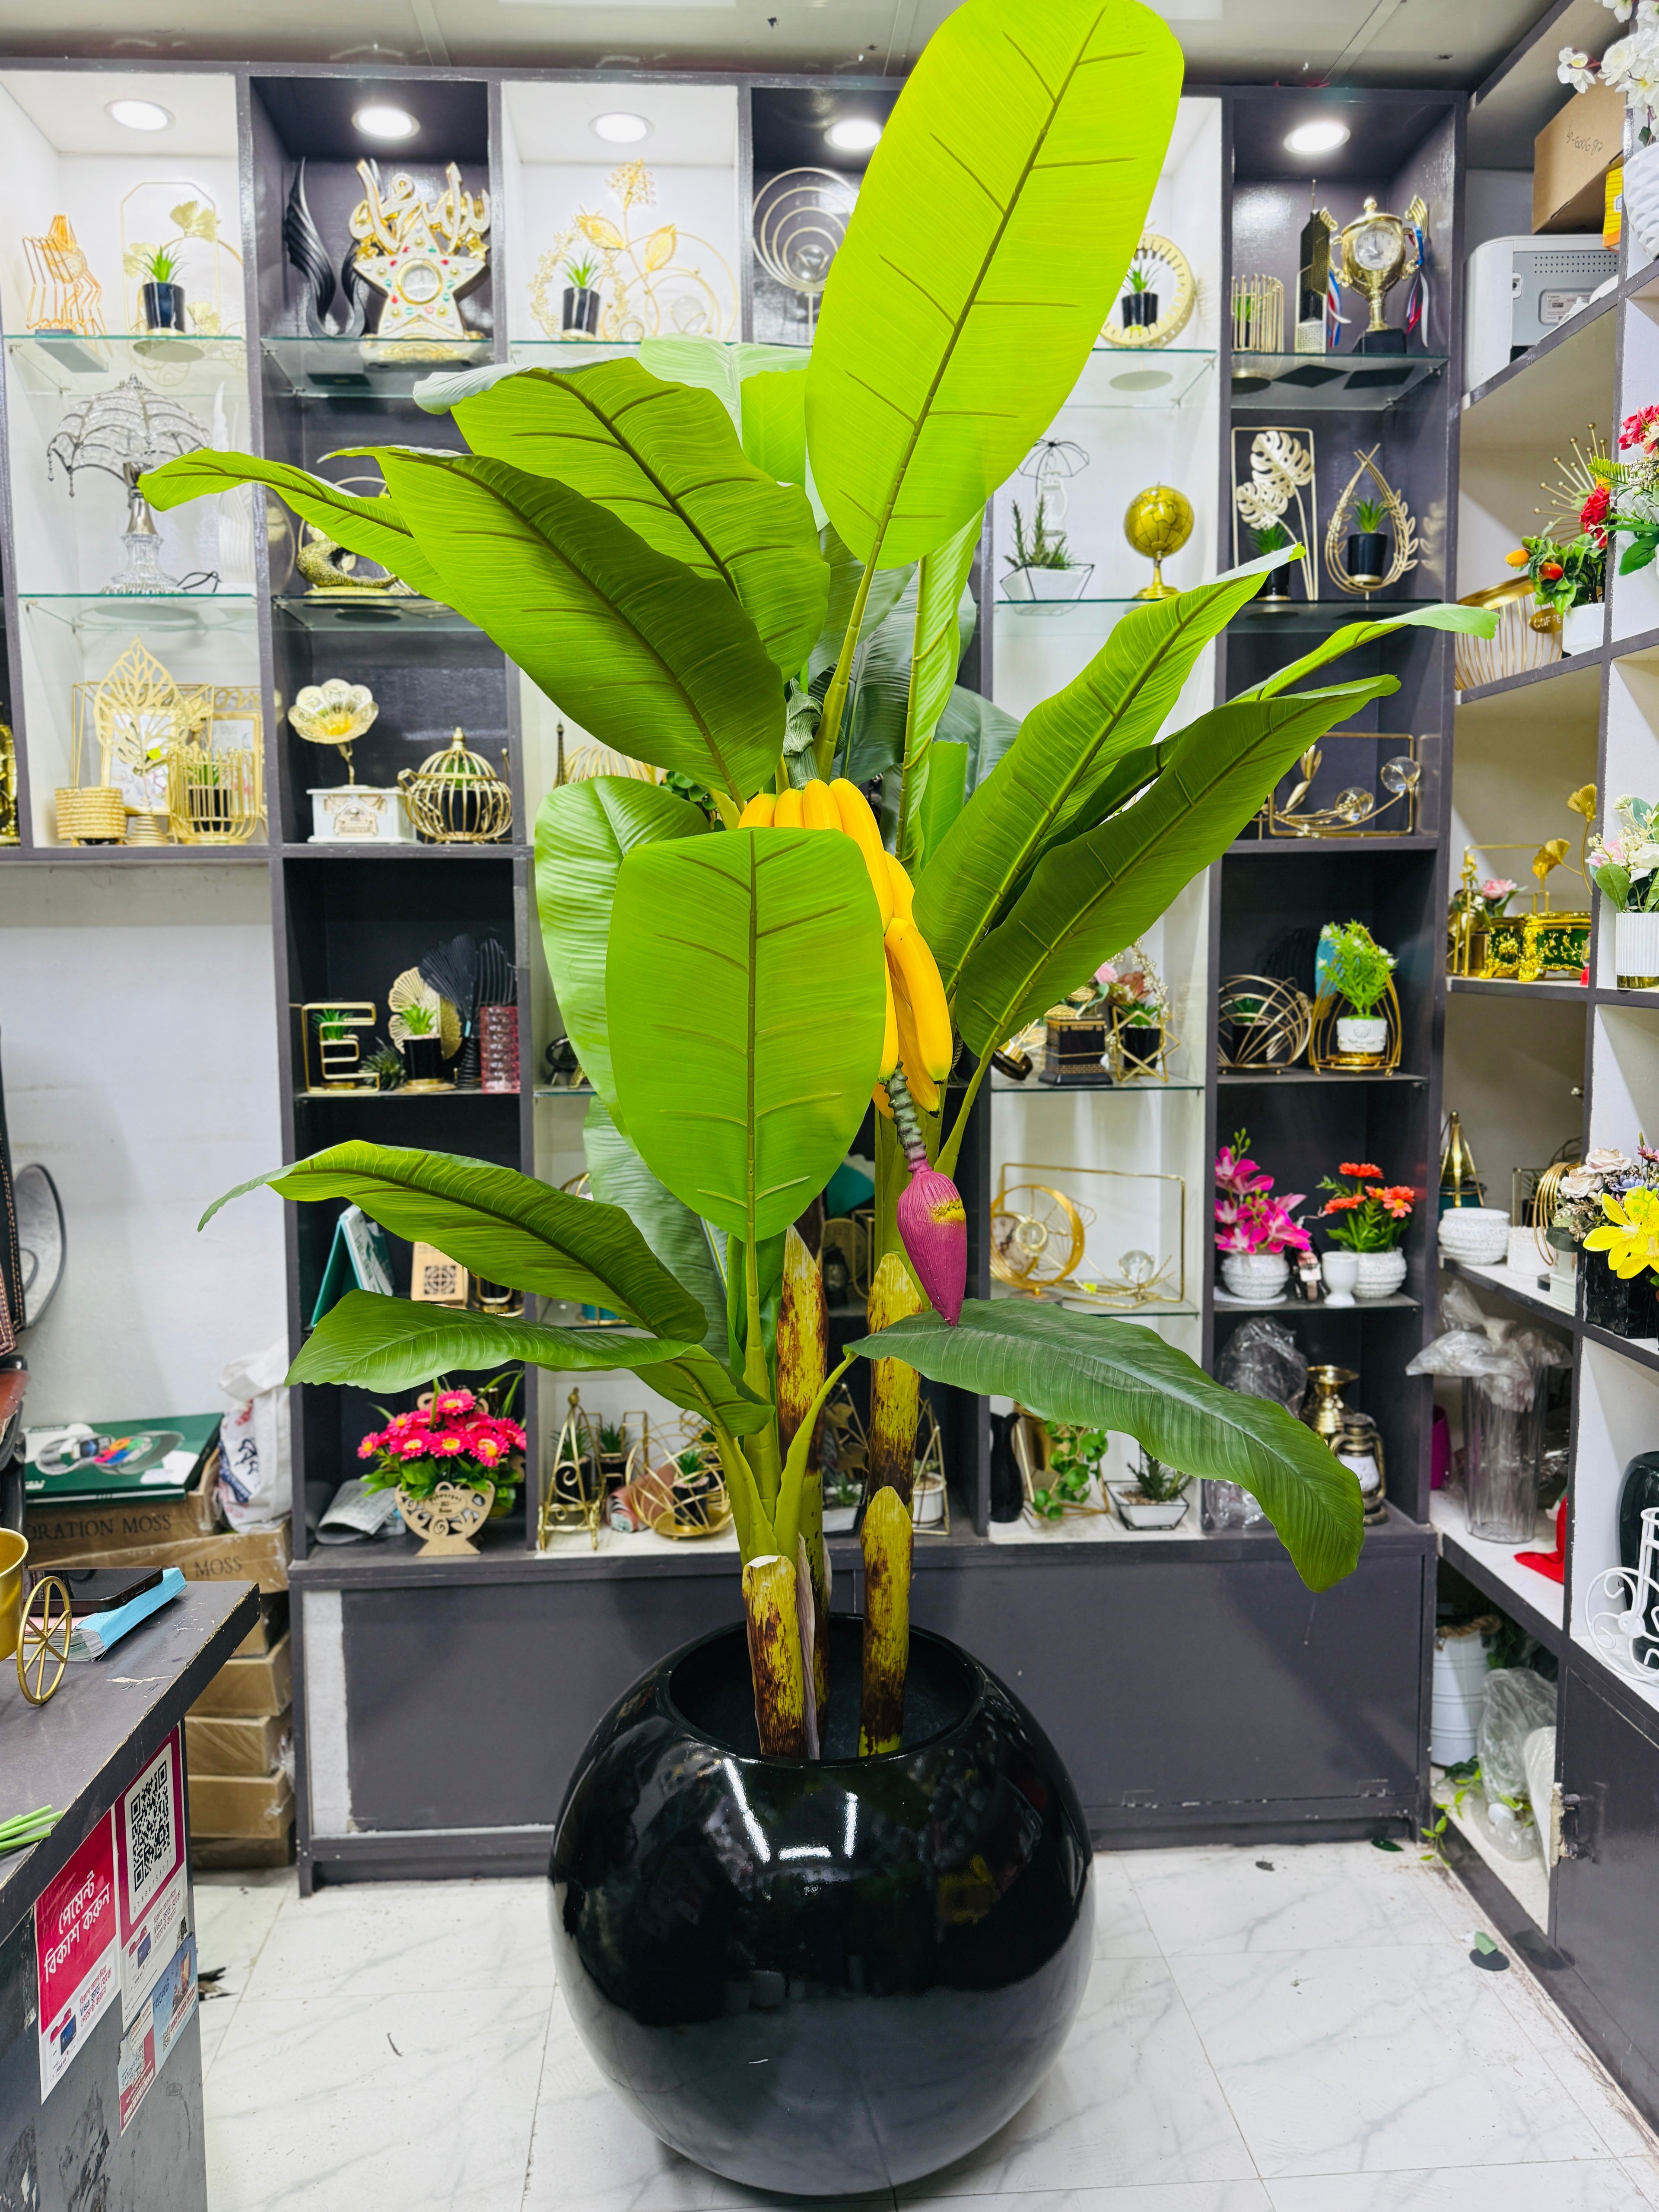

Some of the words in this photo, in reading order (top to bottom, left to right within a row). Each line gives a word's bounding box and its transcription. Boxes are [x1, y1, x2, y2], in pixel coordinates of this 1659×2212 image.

[123, 1514, 172, 1534] MOSS
[195, 1556, 242, 1577] MOSS
[59, 1870, 95, 1935] পেমেন্ট
[44, 1920, 80, 1983] বিকাশ
[82, 1882, 110, 1930] করুন
